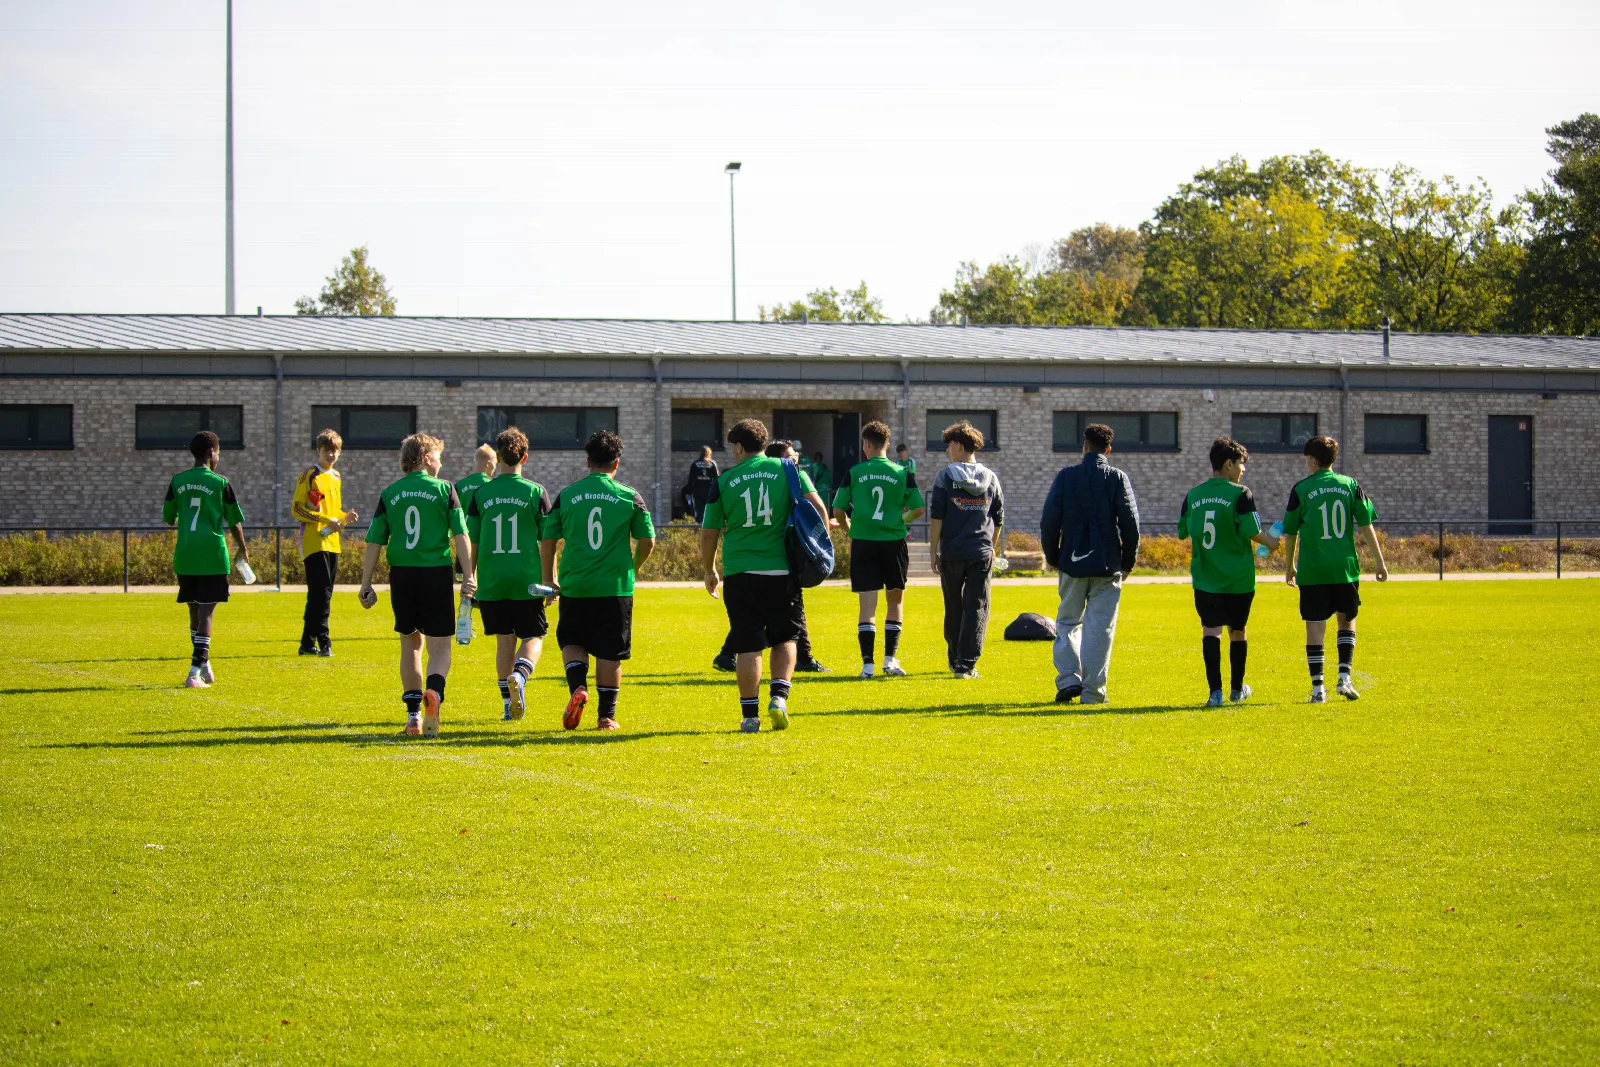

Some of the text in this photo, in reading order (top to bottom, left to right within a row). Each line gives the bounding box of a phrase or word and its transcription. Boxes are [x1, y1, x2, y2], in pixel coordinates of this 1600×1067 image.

[186, 483, 214, 496] Brockdorf
[729, 471, 778, 488] GW Brockdorf
[869, 473, 898, 485] Brockdorf
[1318, 486, 1350, 497] Brockdorf
[401, 490, 438, 502] Brockdorf
[483, 496, 529, 509] GW Brockdorf
[570, 492, 620, 505] GW Brockdorf
[739, 480, 774, 528] 14
[871, 485, 884, 522] 2
[1201, 496, 1232, 508] Brockdorf
[189, 496, 201, 532] 7
[1317, 499, 1347, 540] 10
[404, 505, 421, 550] 9
[491, 511, 521, 554] 11
[587, 506, 603, 551] 6
[1202, 509, 1216, 550] 5
